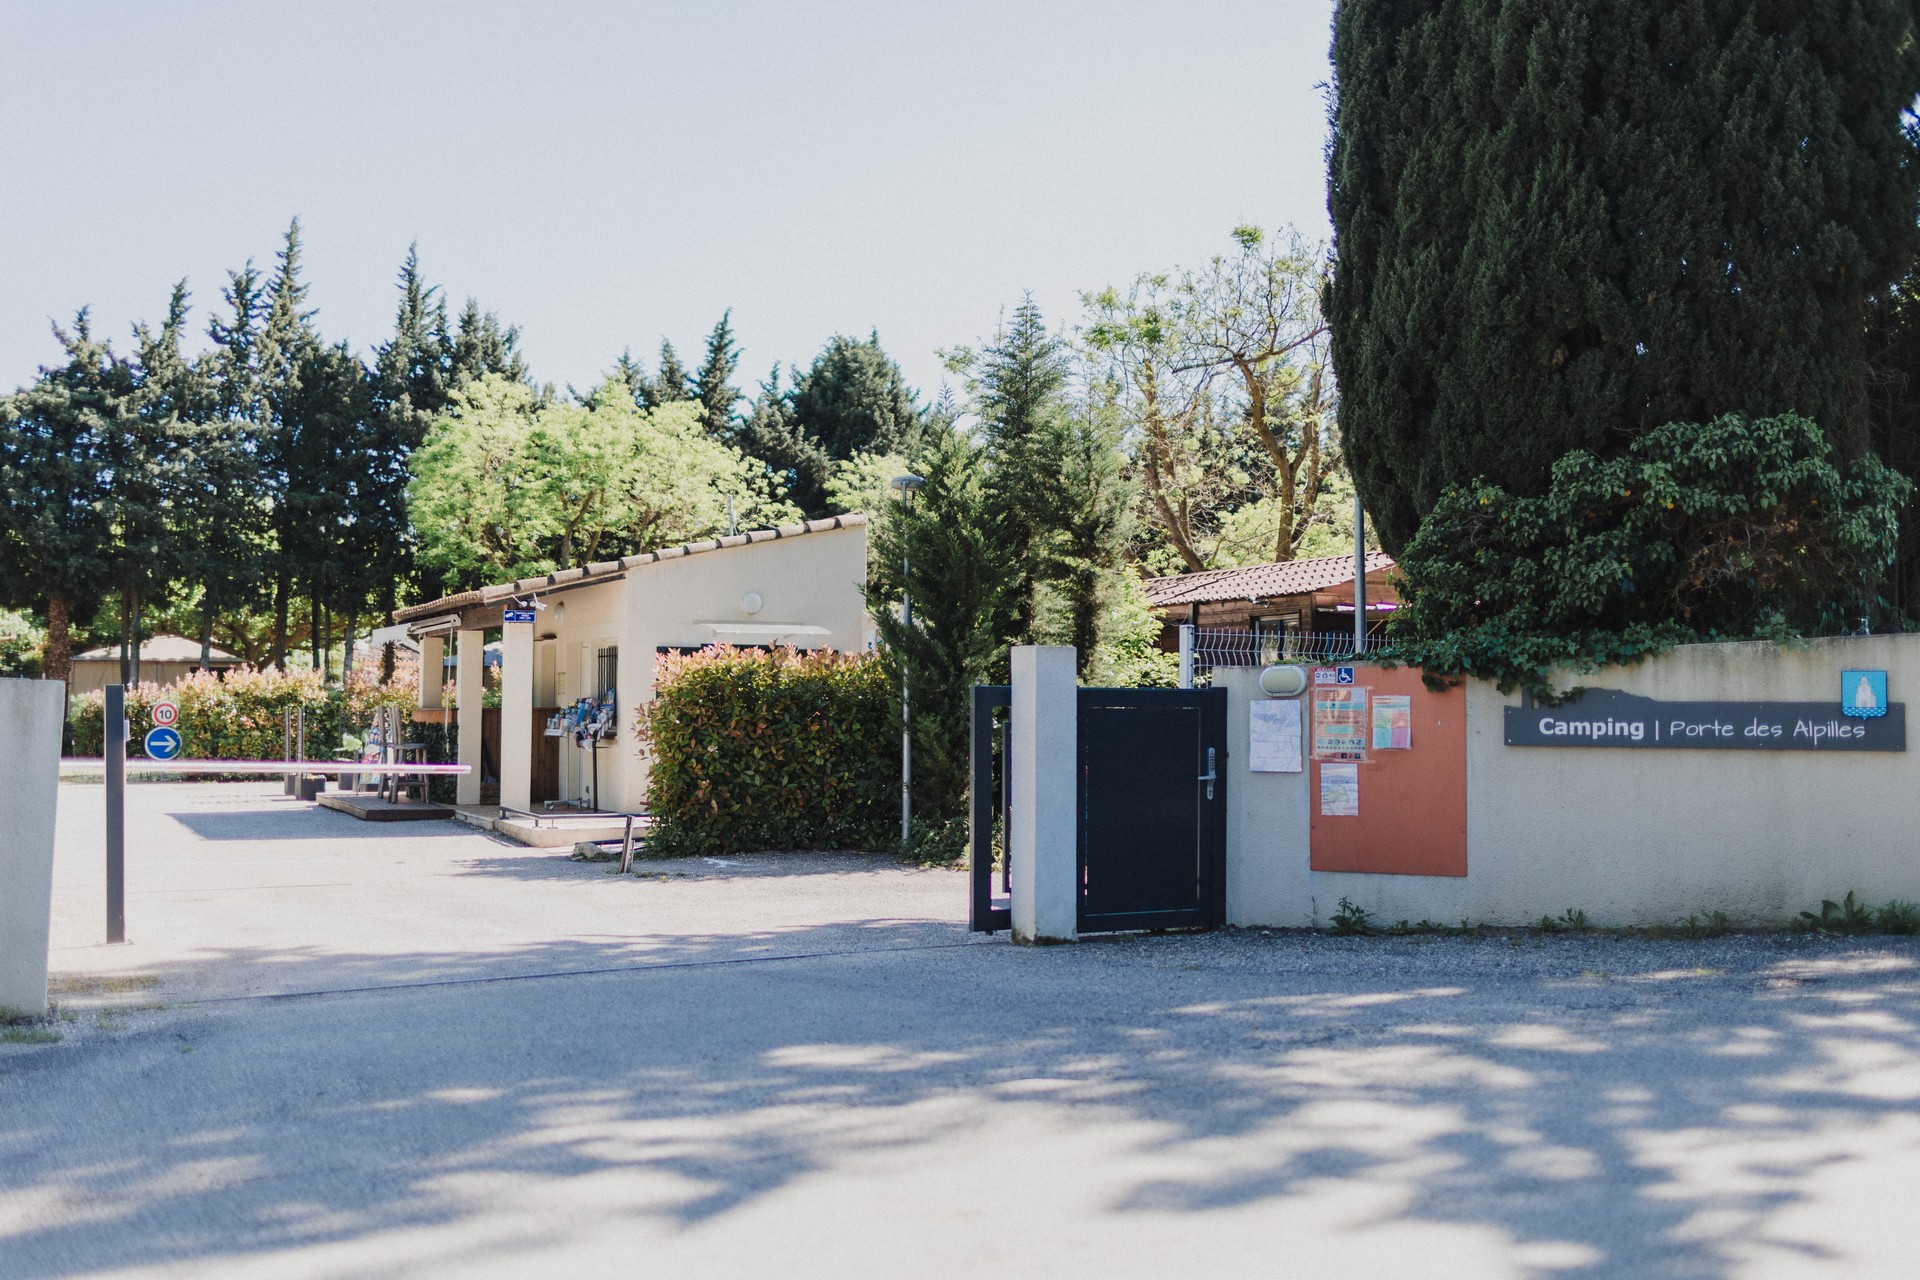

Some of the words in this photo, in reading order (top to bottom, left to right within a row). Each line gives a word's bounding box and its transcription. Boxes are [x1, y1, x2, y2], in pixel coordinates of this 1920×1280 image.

[159, 710, 172, 719] 10
[1539, 717, 1645, 740] Camping
[1670, 720, 1735, 737] Porte
[1744, 717, 1783, 738] des
[1793, 719, 1866, 745] Alpilles
